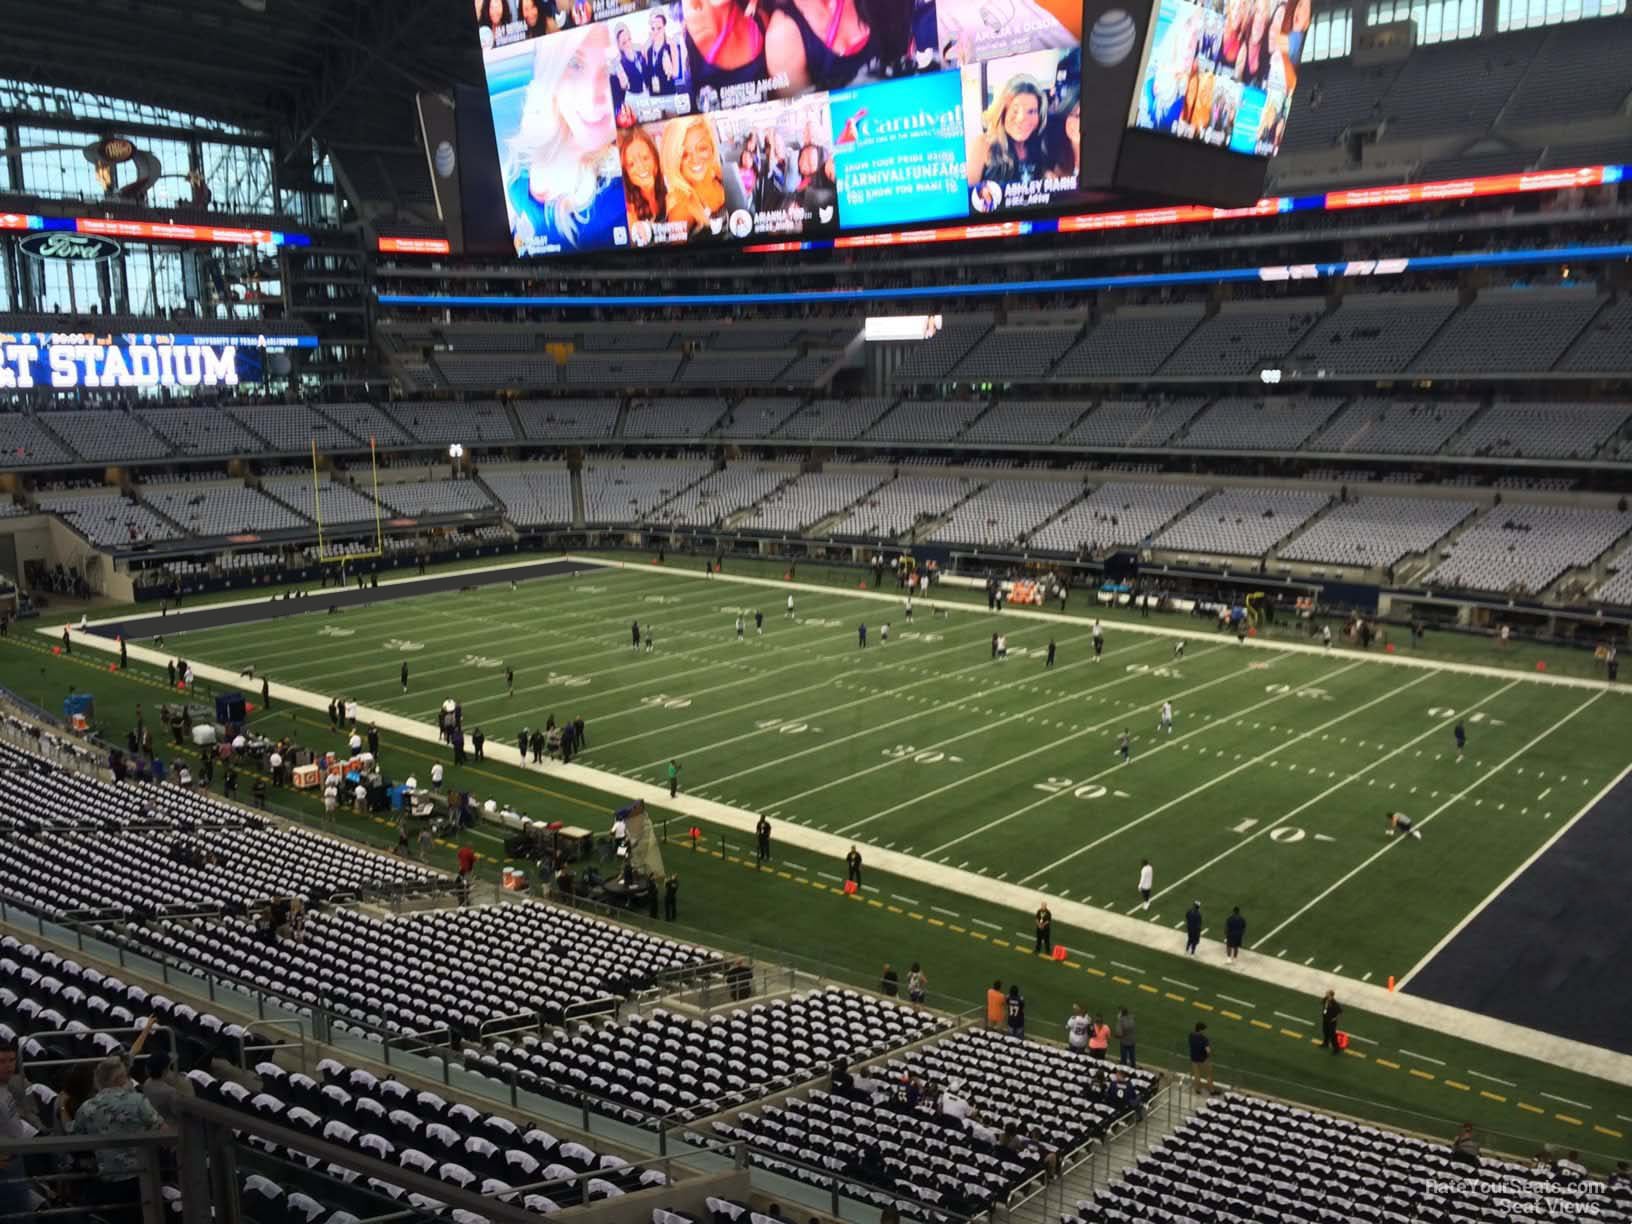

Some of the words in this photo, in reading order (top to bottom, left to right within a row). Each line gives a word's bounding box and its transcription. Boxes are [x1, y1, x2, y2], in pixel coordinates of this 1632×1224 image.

[860, 104, 962, 137] Carnival
[40, 233, 102, 259] Ford
[50, 344, 239, 388] STADIUM
[1231, 816, 1306, 843] 10
